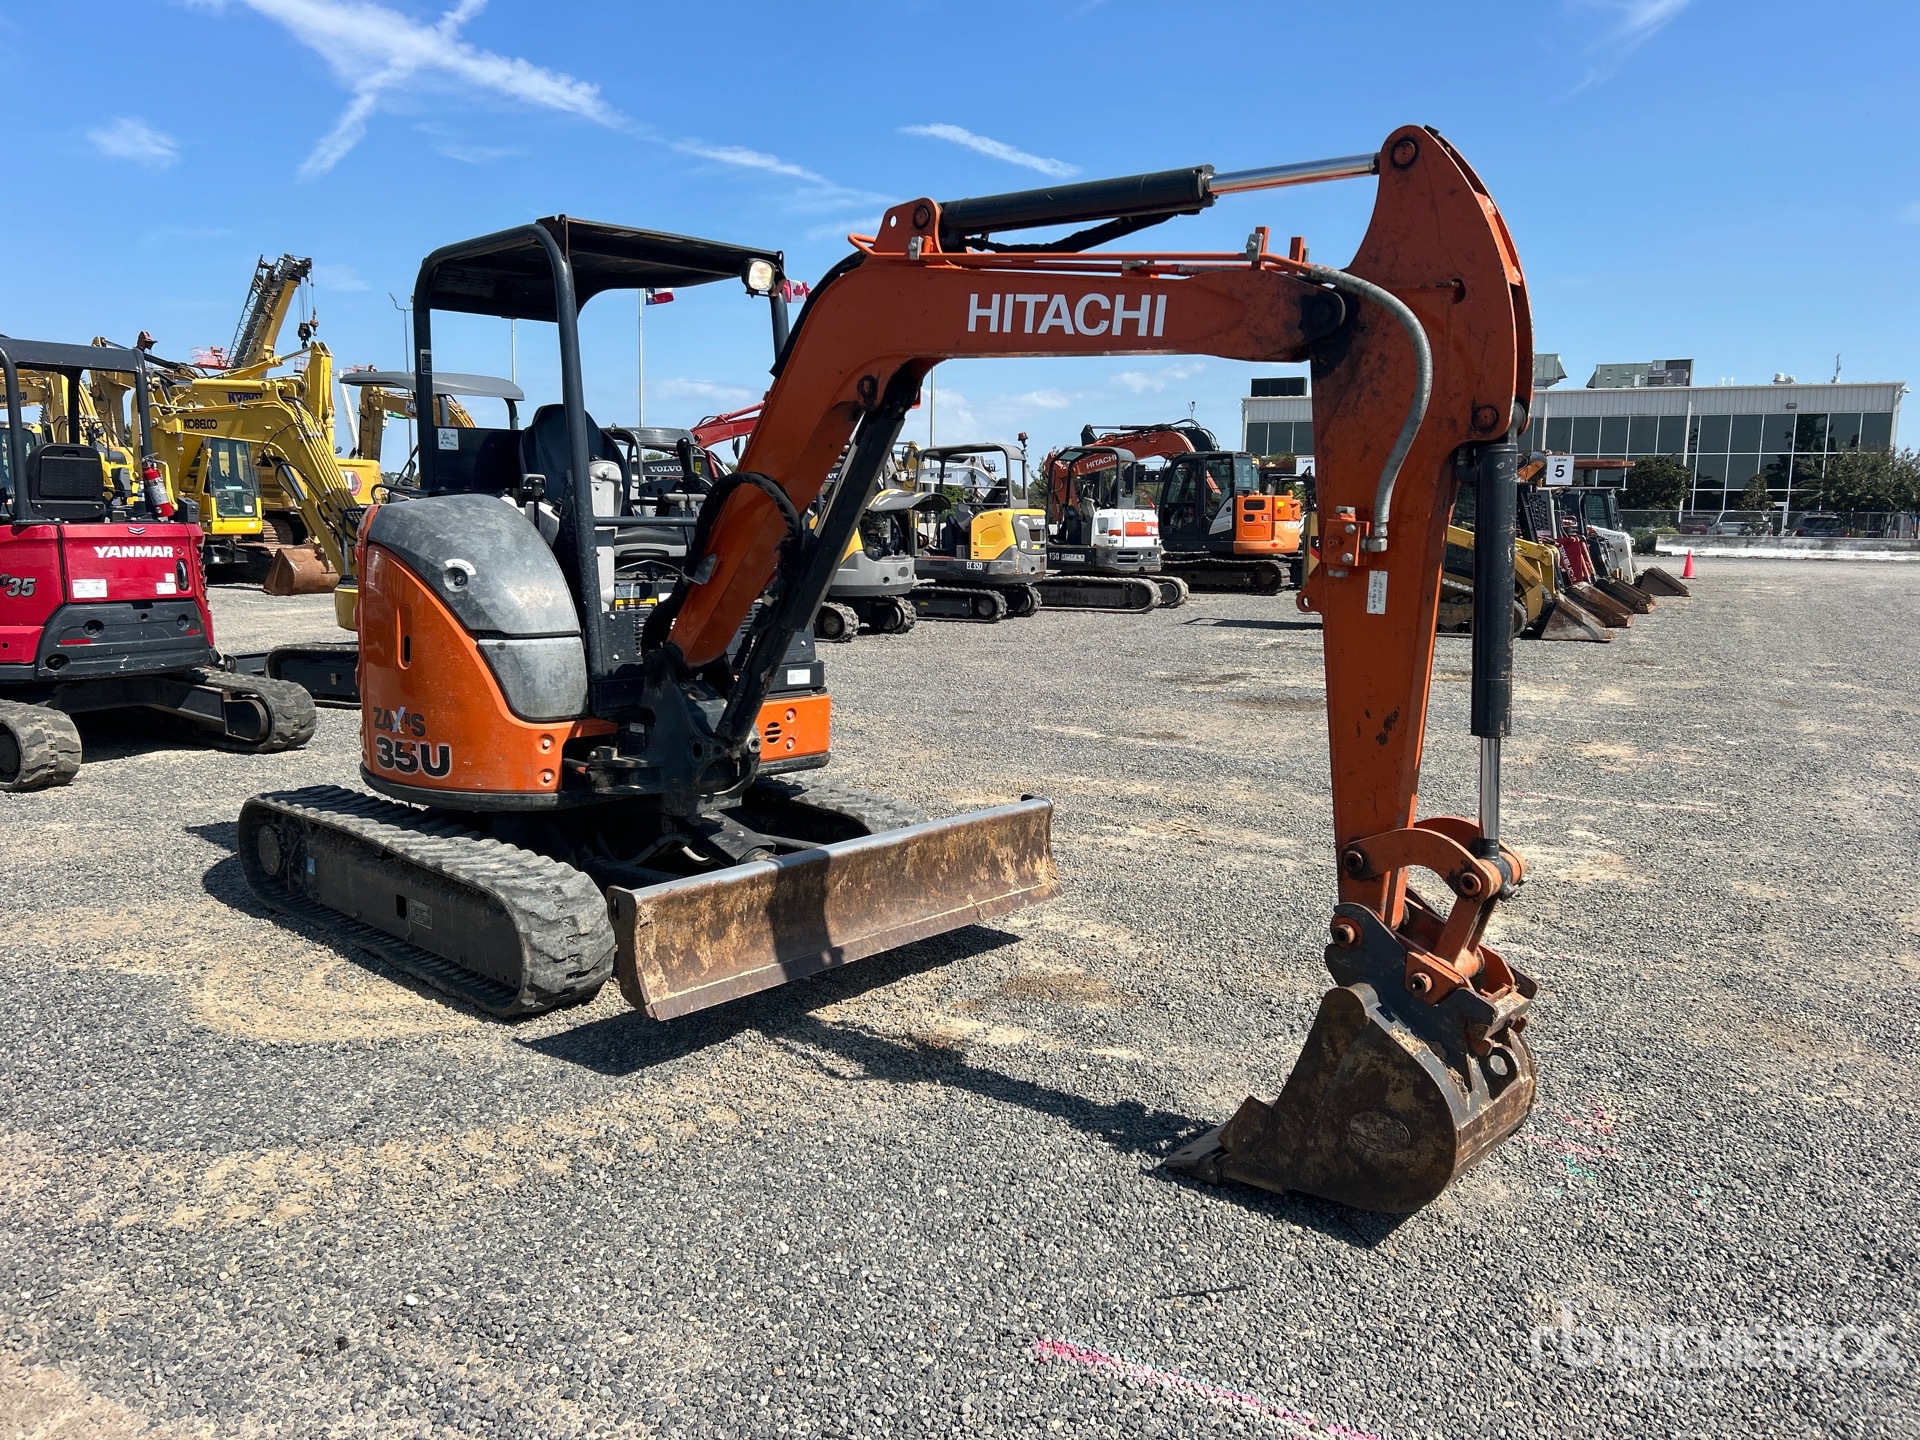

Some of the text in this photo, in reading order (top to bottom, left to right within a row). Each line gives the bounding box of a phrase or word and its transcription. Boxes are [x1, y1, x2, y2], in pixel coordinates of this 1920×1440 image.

[967, 293, 1167, 337] HITACHI
[184, 419, 217, 430] KOBELCO
[1086, 454, 1117, 469] HITACHI
[649, 465, 683, 473] VOLVO
[1554, 464, 1565, 478] 5
[93, 546, 174, 558] YANMAR
[373, 706, 426, 737] ZAXIS
[376, 735, 452, 778] 35U
